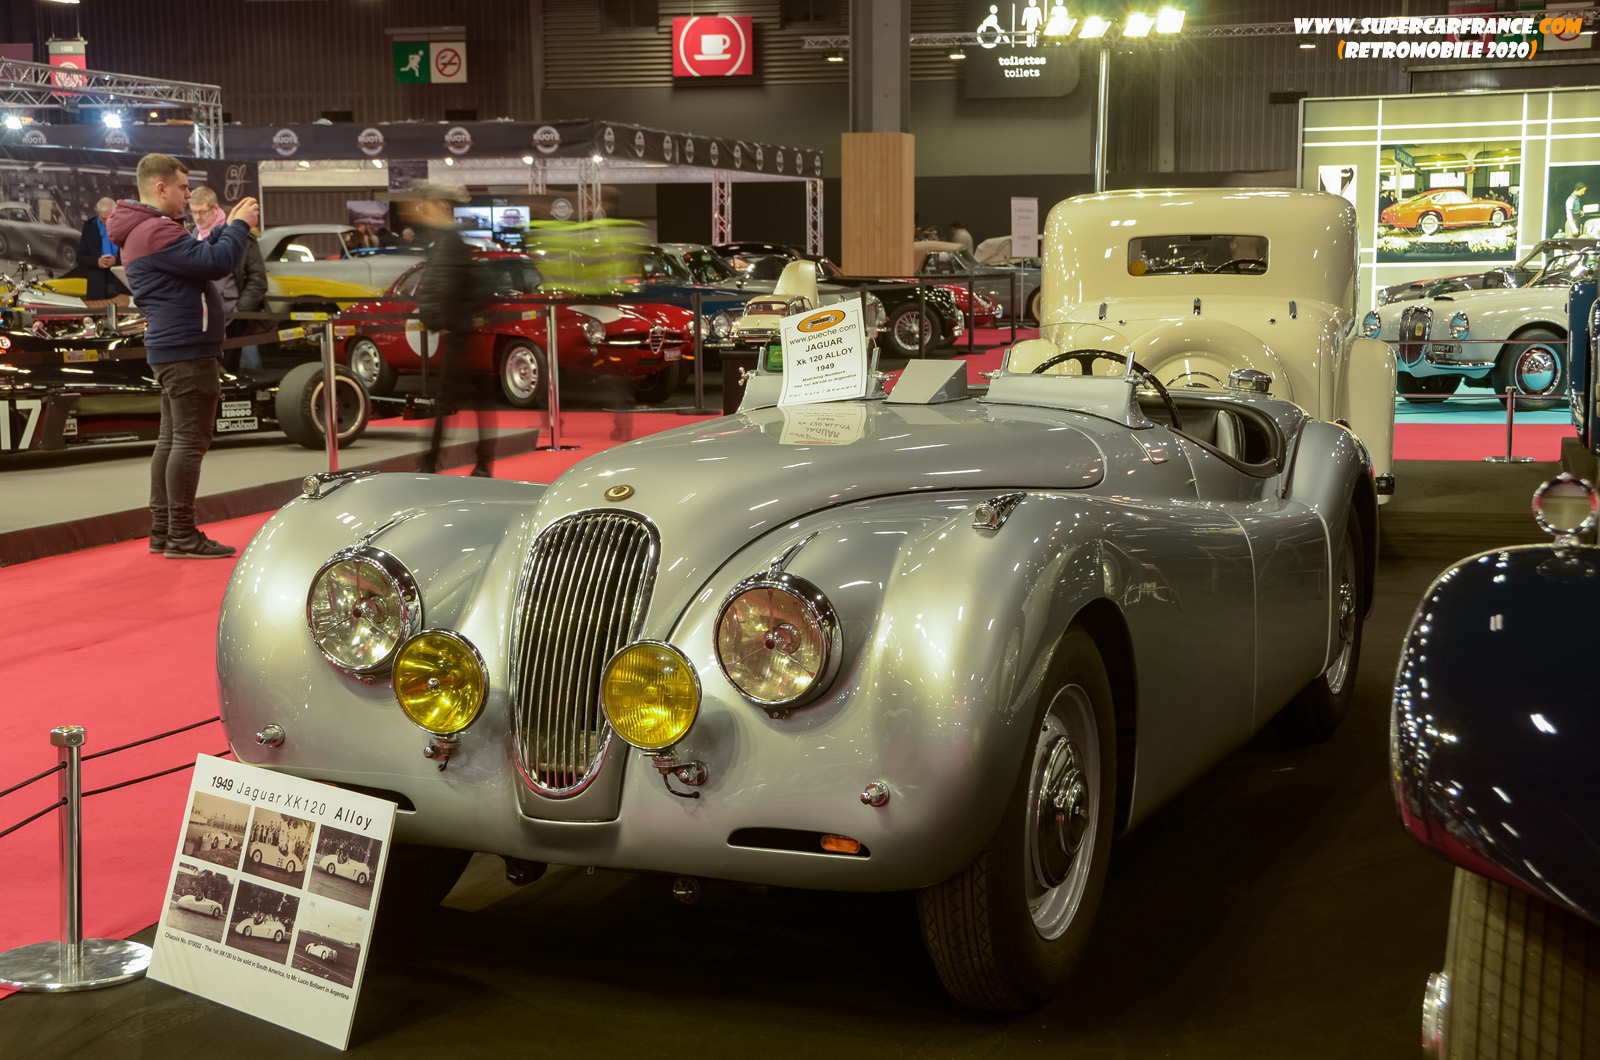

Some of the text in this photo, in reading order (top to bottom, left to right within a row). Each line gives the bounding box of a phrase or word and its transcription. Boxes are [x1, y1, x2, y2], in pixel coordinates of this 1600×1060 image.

[998, 55, 1047, 66] toilettes
[1004, 67, 1041, 78] toilets
[789, 323, 857, 346] www.pueche.com
[805, 337, 843, 353] JAGUAR
[796, 346, 854, 366] Xk 120 ALLOY
[816, 362, 835, 372] 1949
[222, 409, 252, 417] FERODO
[230, 419, 256, 430] Lockheed
[211, 775, 372, 831] 1949 Jaguar XK120 Alloy
[276, 857, 284, 867] 26
[164, 932, 180, 942] Chassis
[219, 950, 232, 959] XK120
[243, 957, 251, 966] sold
[256, 962, 268, 972] South
[268, 966, 285, 978] America,
[298, 977, 309, 986] Lucio
[310, 981, 326, 991] Bollaert
[330, 988, 350, 1000] Argentina
